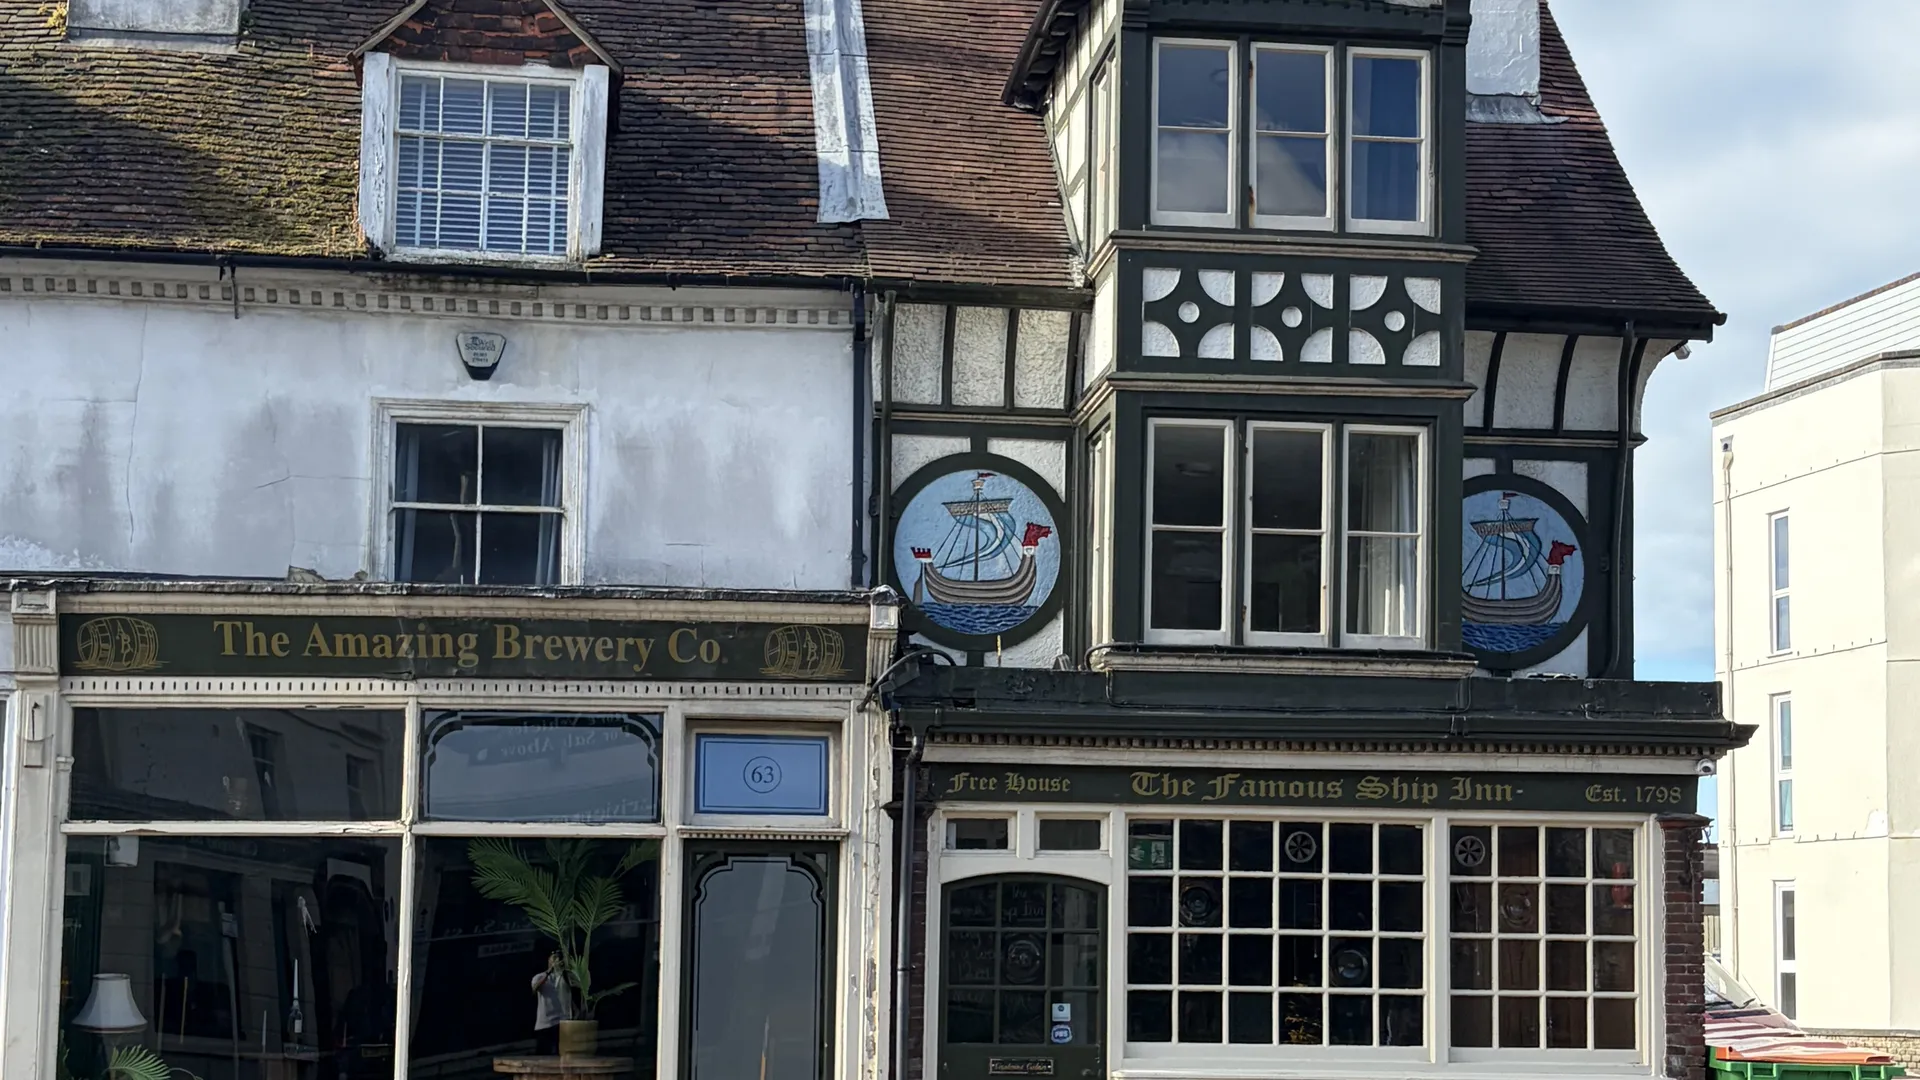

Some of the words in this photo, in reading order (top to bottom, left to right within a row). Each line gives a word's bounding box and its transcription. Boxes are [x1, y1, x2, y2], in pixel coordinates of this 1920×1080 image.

[213, 620, 290, 656] The
[302, 622, 479, 668] Amazing
[492, 624, 655, 672] Brewery
[751, 766, 774, 783] 63
[946, 772, 998, 794] Free
[1005, 772, 1071, 794] House
[1130, 771, 1195, 799] The
[1201, 773, 1343, 801] Famous
[1355, 775, 1438, 804] Ship
[1585, 784, 1627, 803] Est.
[1635, 786, 1682, 804] 1798
